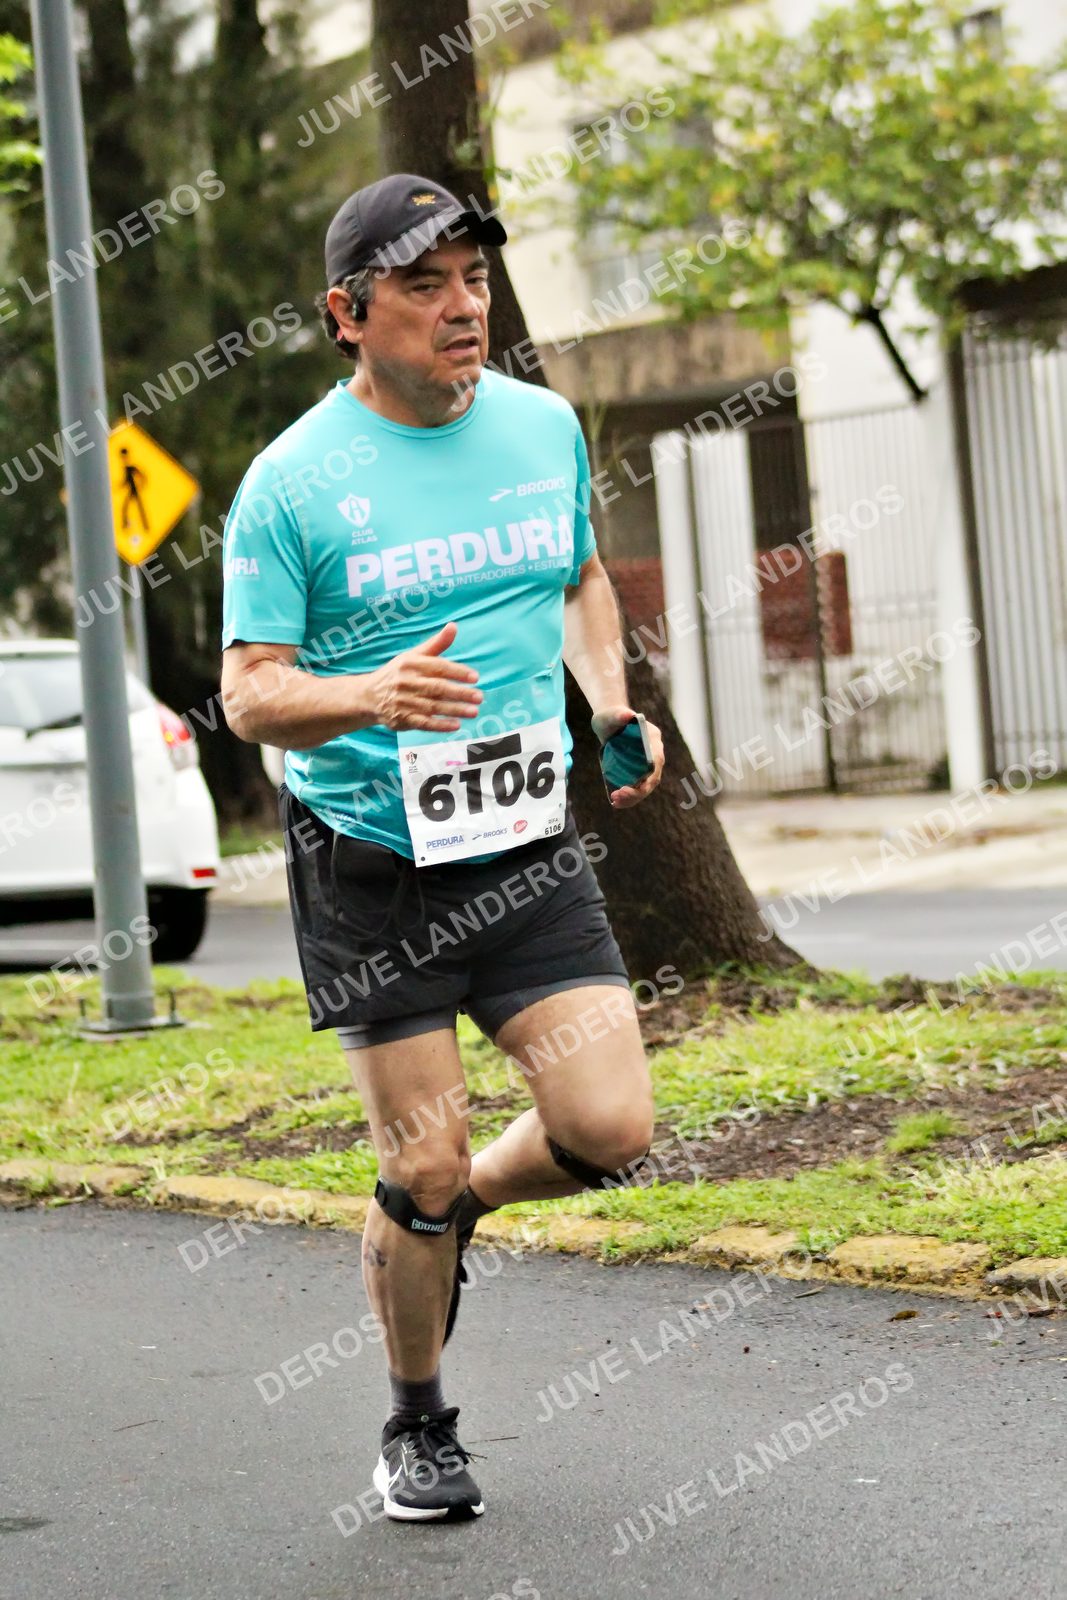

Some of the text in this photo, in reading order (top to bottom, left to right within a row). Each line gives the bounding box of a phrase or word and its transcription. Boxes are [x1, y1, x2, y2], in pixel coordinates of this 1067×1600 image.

[516, 477, 567, 497] BROOKS
[345, 514, 573, 598] PERDURA
[418, 751, 556, 823] 6106
[426, 835, 464, 849] PERDURA
[483, 828, 508, 838] BROOKS
[544, 823, 562, 835] 6106
